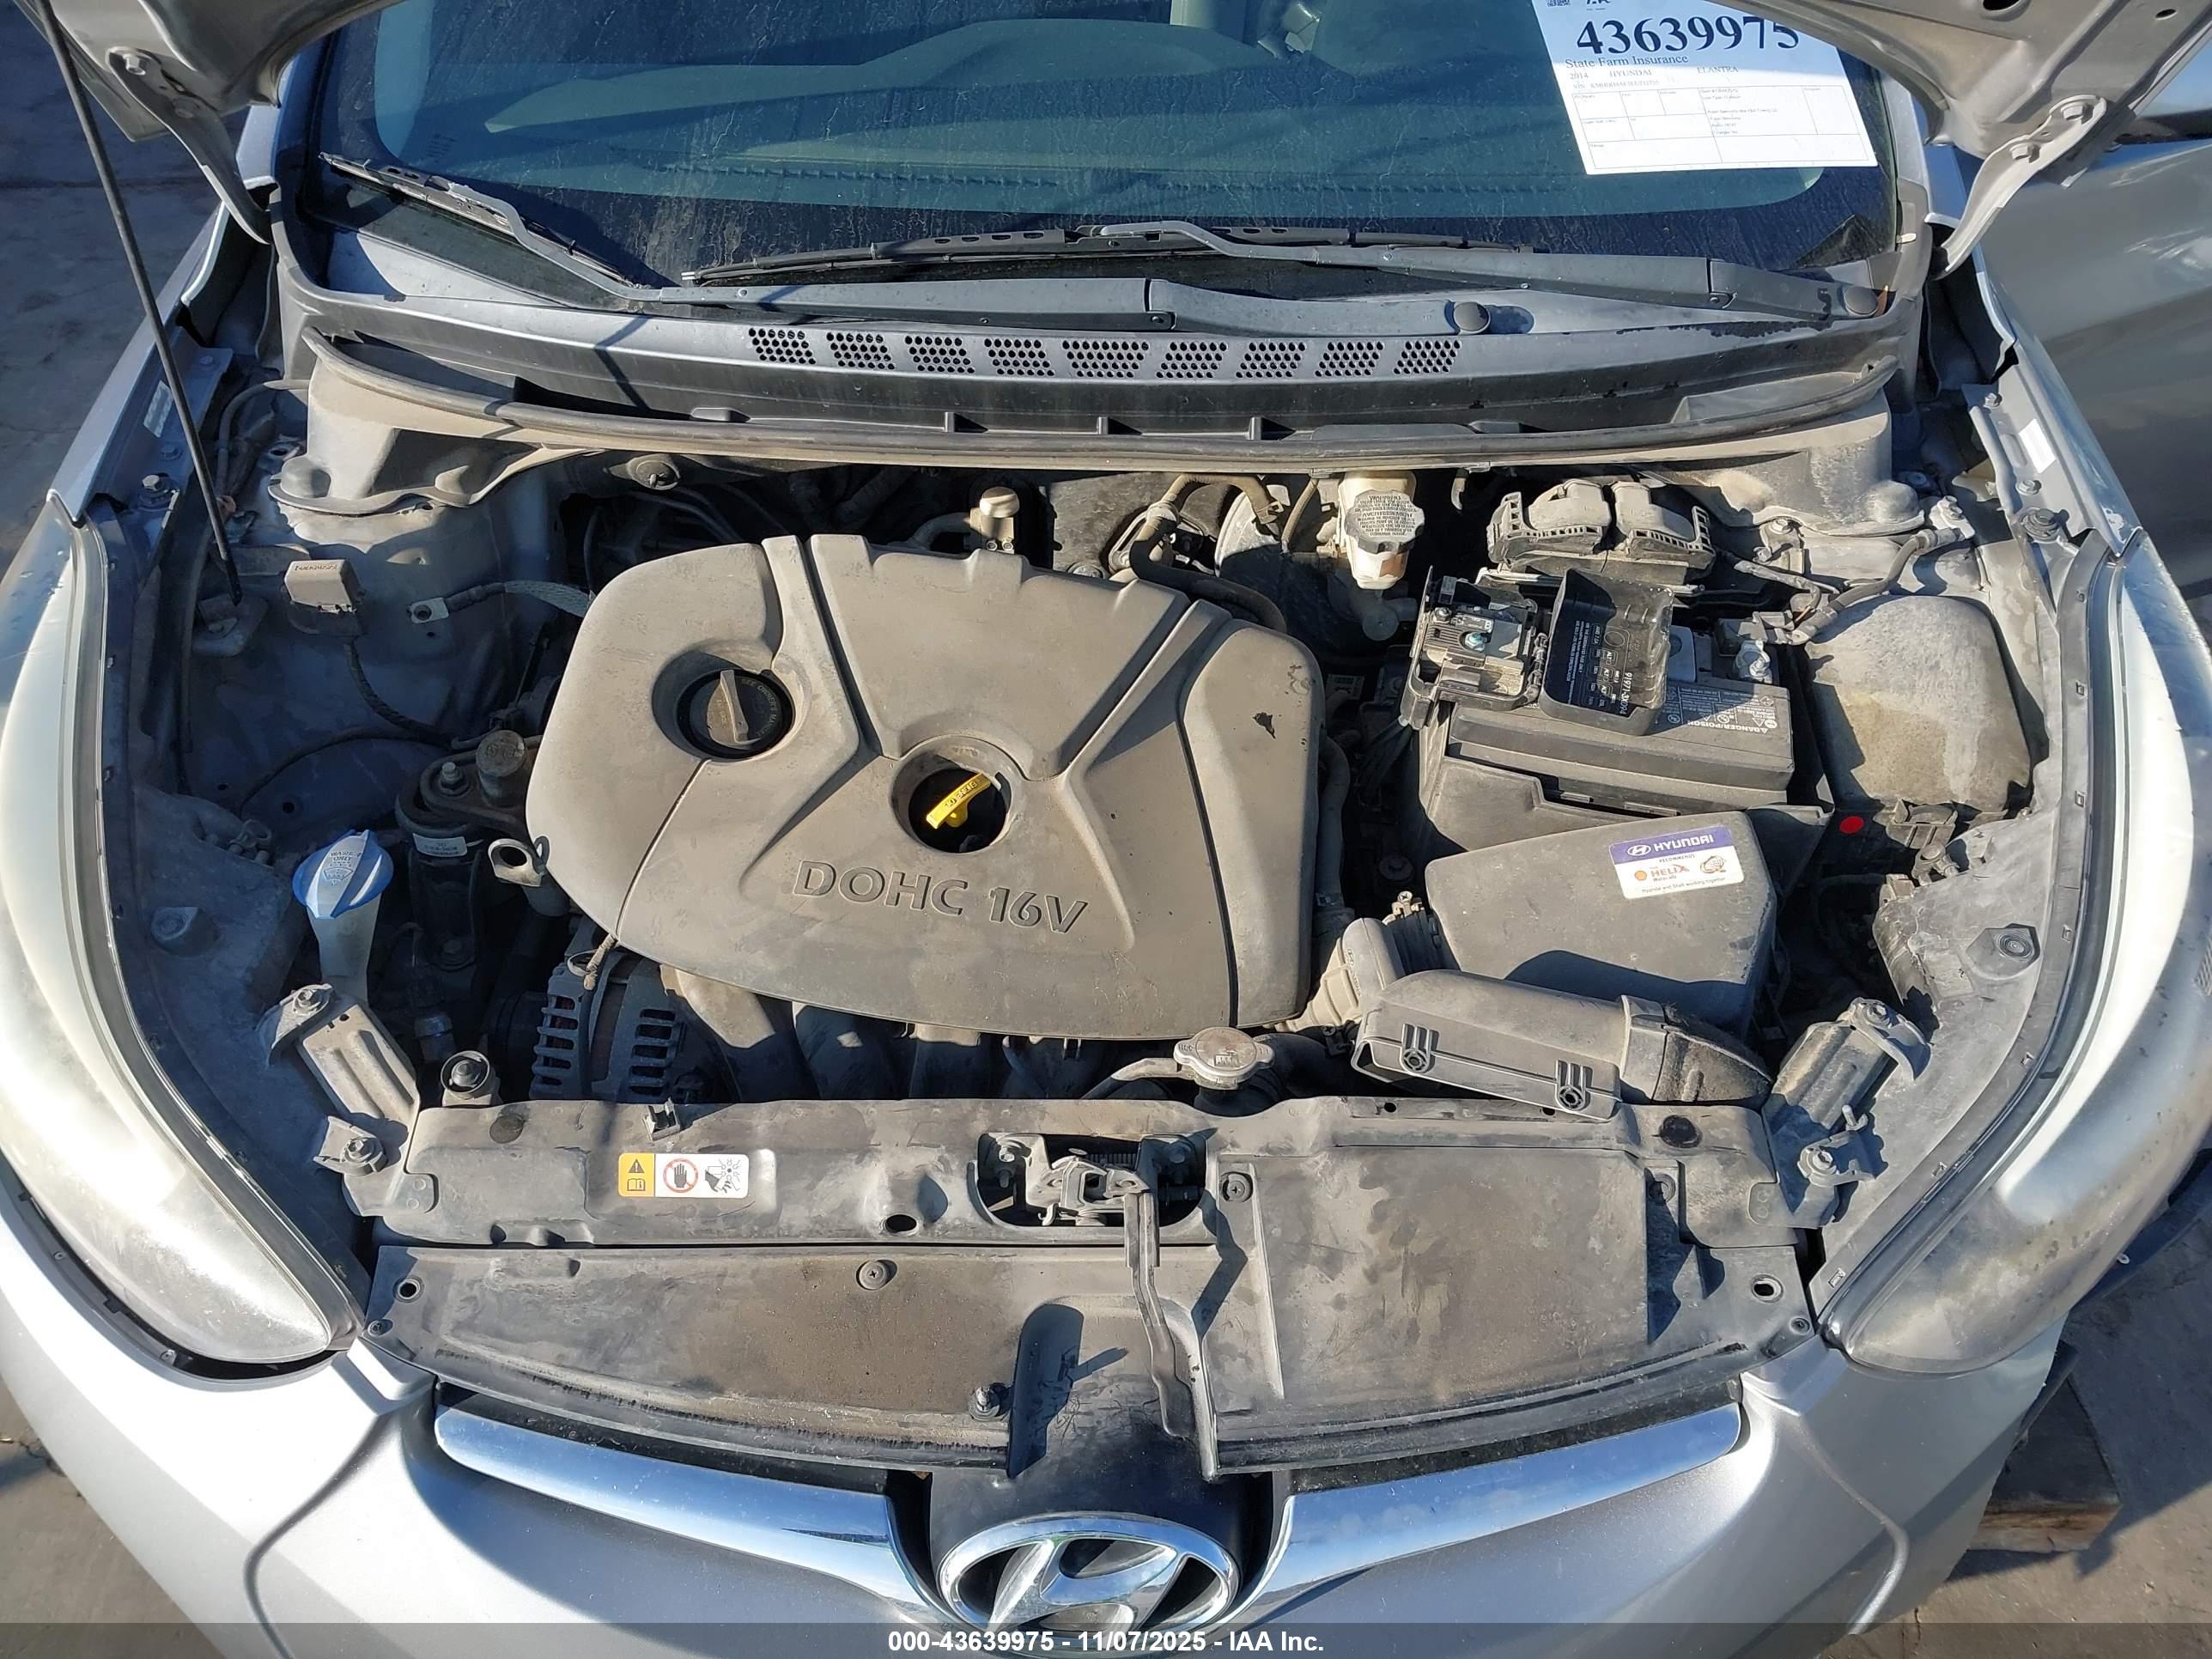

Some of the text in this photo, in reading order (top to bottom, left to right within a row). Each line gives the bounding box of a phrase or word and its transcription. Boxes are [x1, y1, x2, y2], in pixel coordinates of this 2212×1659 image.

[1577, 15, 1799, 54] 43639975
[1565, 55, 1689, 69] State Farm Insurance
[1609, 69, 1652, 77] HYUNDAI
[1697, 65, 1739, 74] ELANTRA
[1620, 672, 1632, 715] 91971-3X094
[1654, 835, 1714, 852] HYUNDAI
[1650, 865, 1689, 878] HELIX
[793, 860, 1089, 934] DOHC 16V
